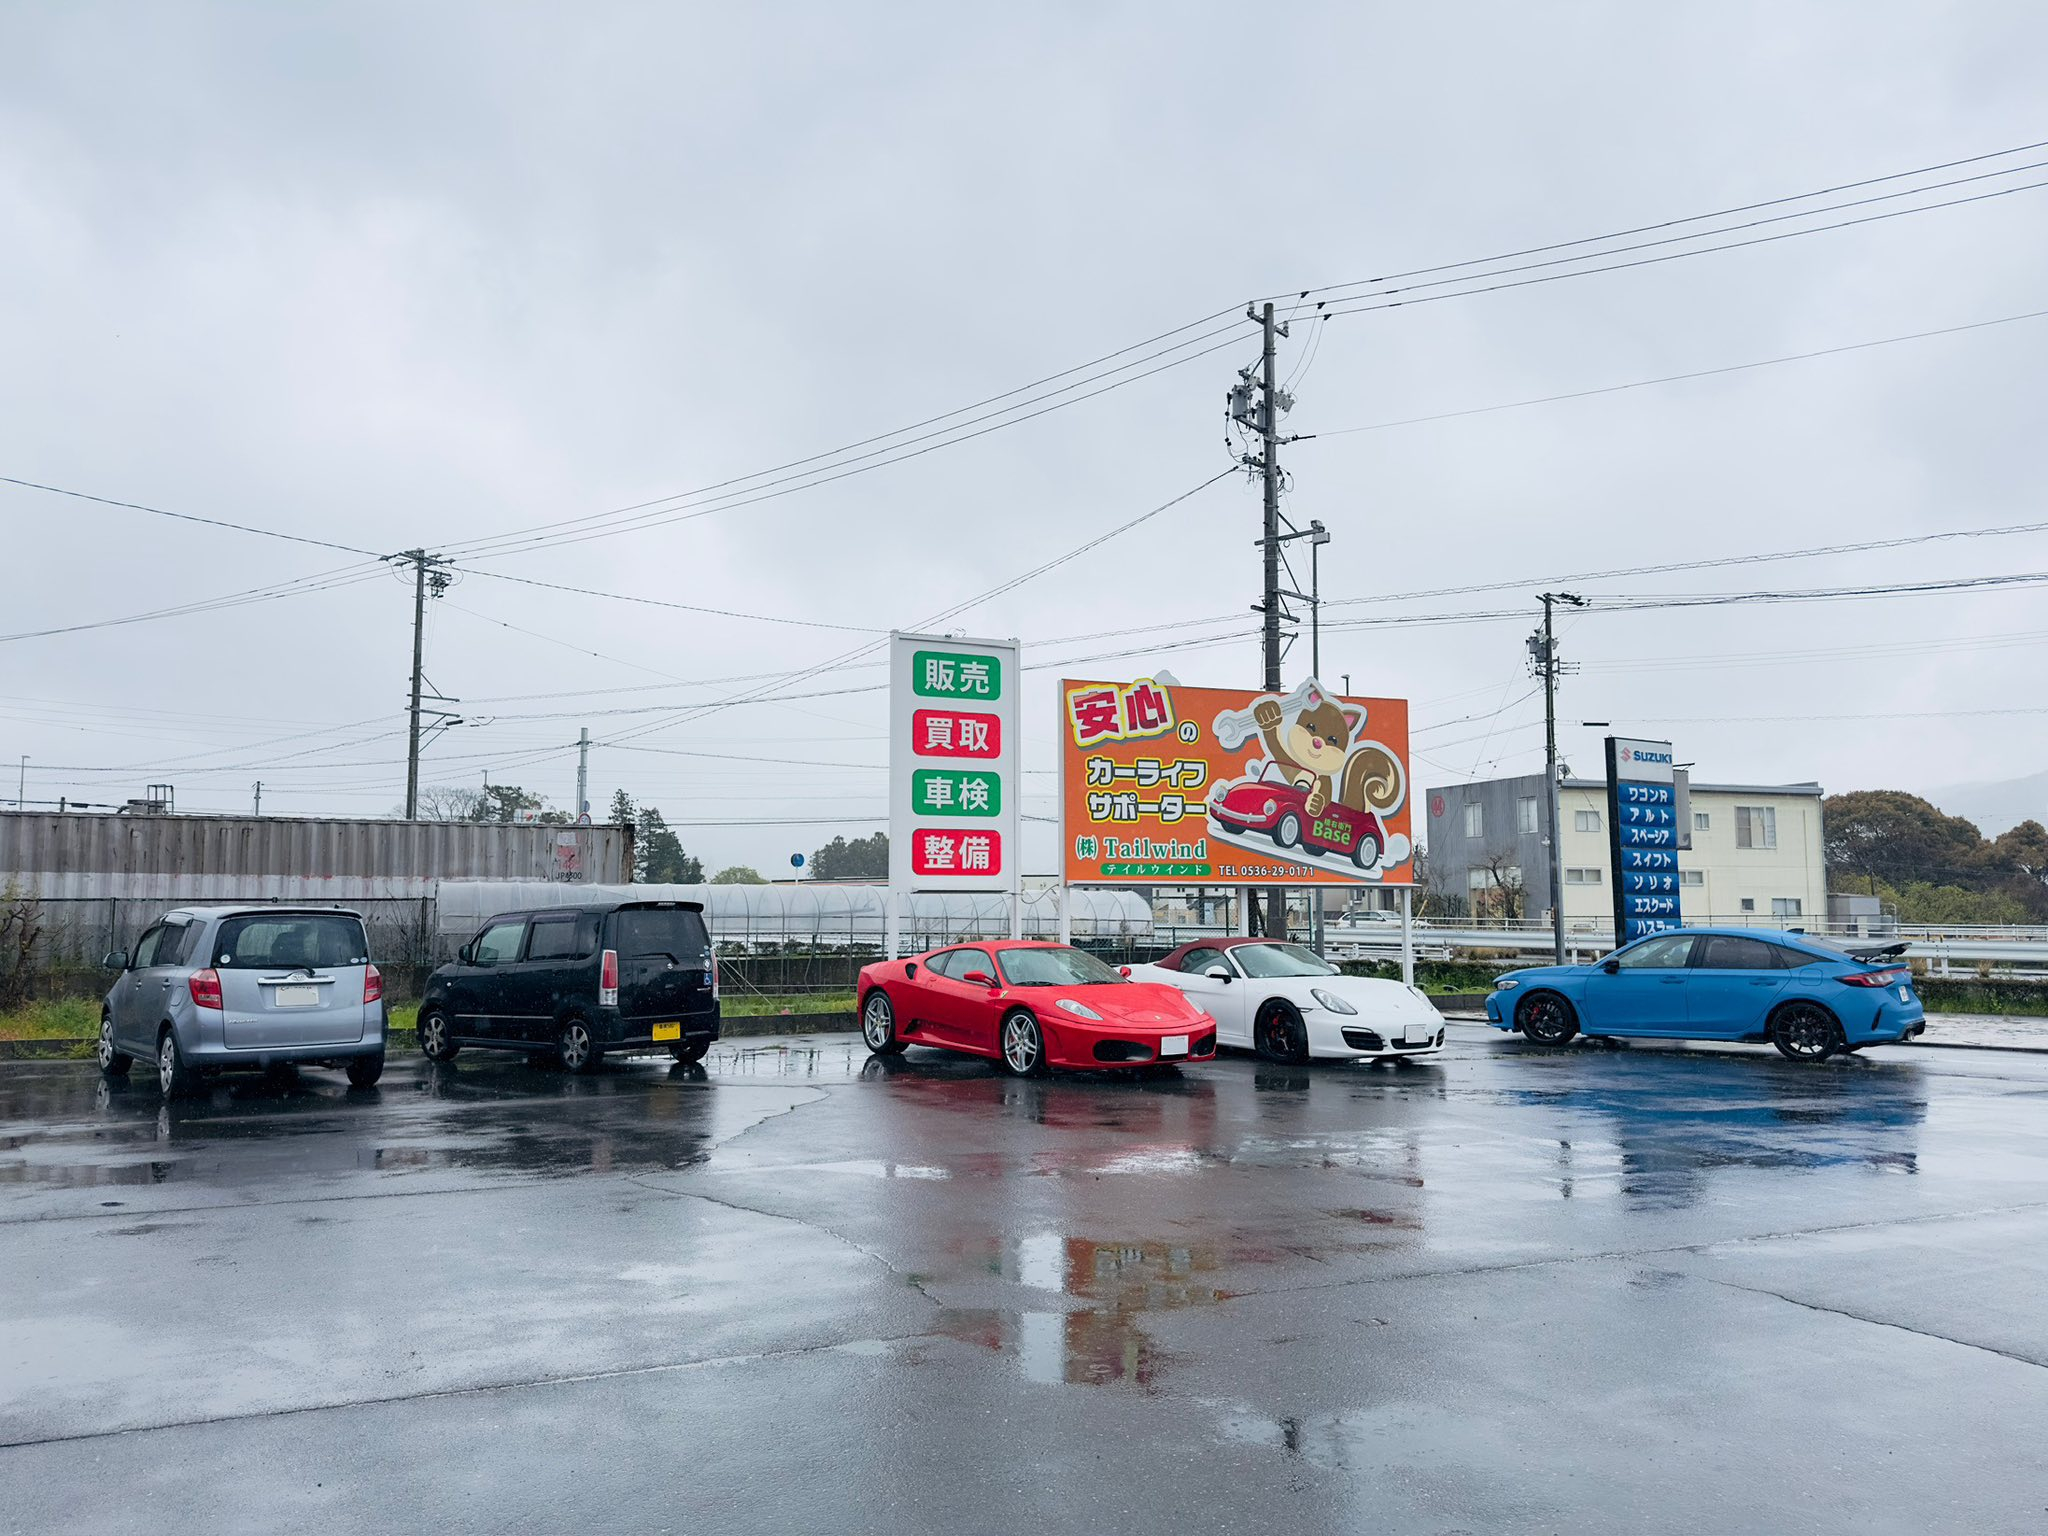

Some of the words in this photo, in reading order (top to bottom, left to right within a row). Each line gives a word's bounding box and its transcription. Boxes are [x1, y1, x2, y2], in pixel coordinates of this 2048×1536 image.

[924, 659, 990, 694] 販売
[1073, 684, 1199, 742] 安心の
[924, 717, 990, 752] 買取
[1633, 750, 1672, 764] SUZUKI
[1088, 757, 1206, 787] カーライフ
[923, 776, 990, 811] 車検
[1628, 787, 1668, 802] ワゴンR
[1088, 793, 1206, 821] サポーター
[1629, 807, 1669, 823] アルト
[1312, 820, 1350, 845] Base
[1631, 828, 1670, 844] スペーシア
[923, 835, 990, 870] 整備
[1104, 838, 1207, 858] Tailwind
[1632, 852, 1672, 867] スイフト
[1107, 864, 1203, 875] テイルウインド
[1218, 865, 1238, 876] TEL
[1240, 865, 1315, 877] 0536-29-0171
[1634, 876, 1673, 890] ソリオ
[1635, 898, 1674, 913] エスクード
[1637, 920, 1675, 935] ハスラー
